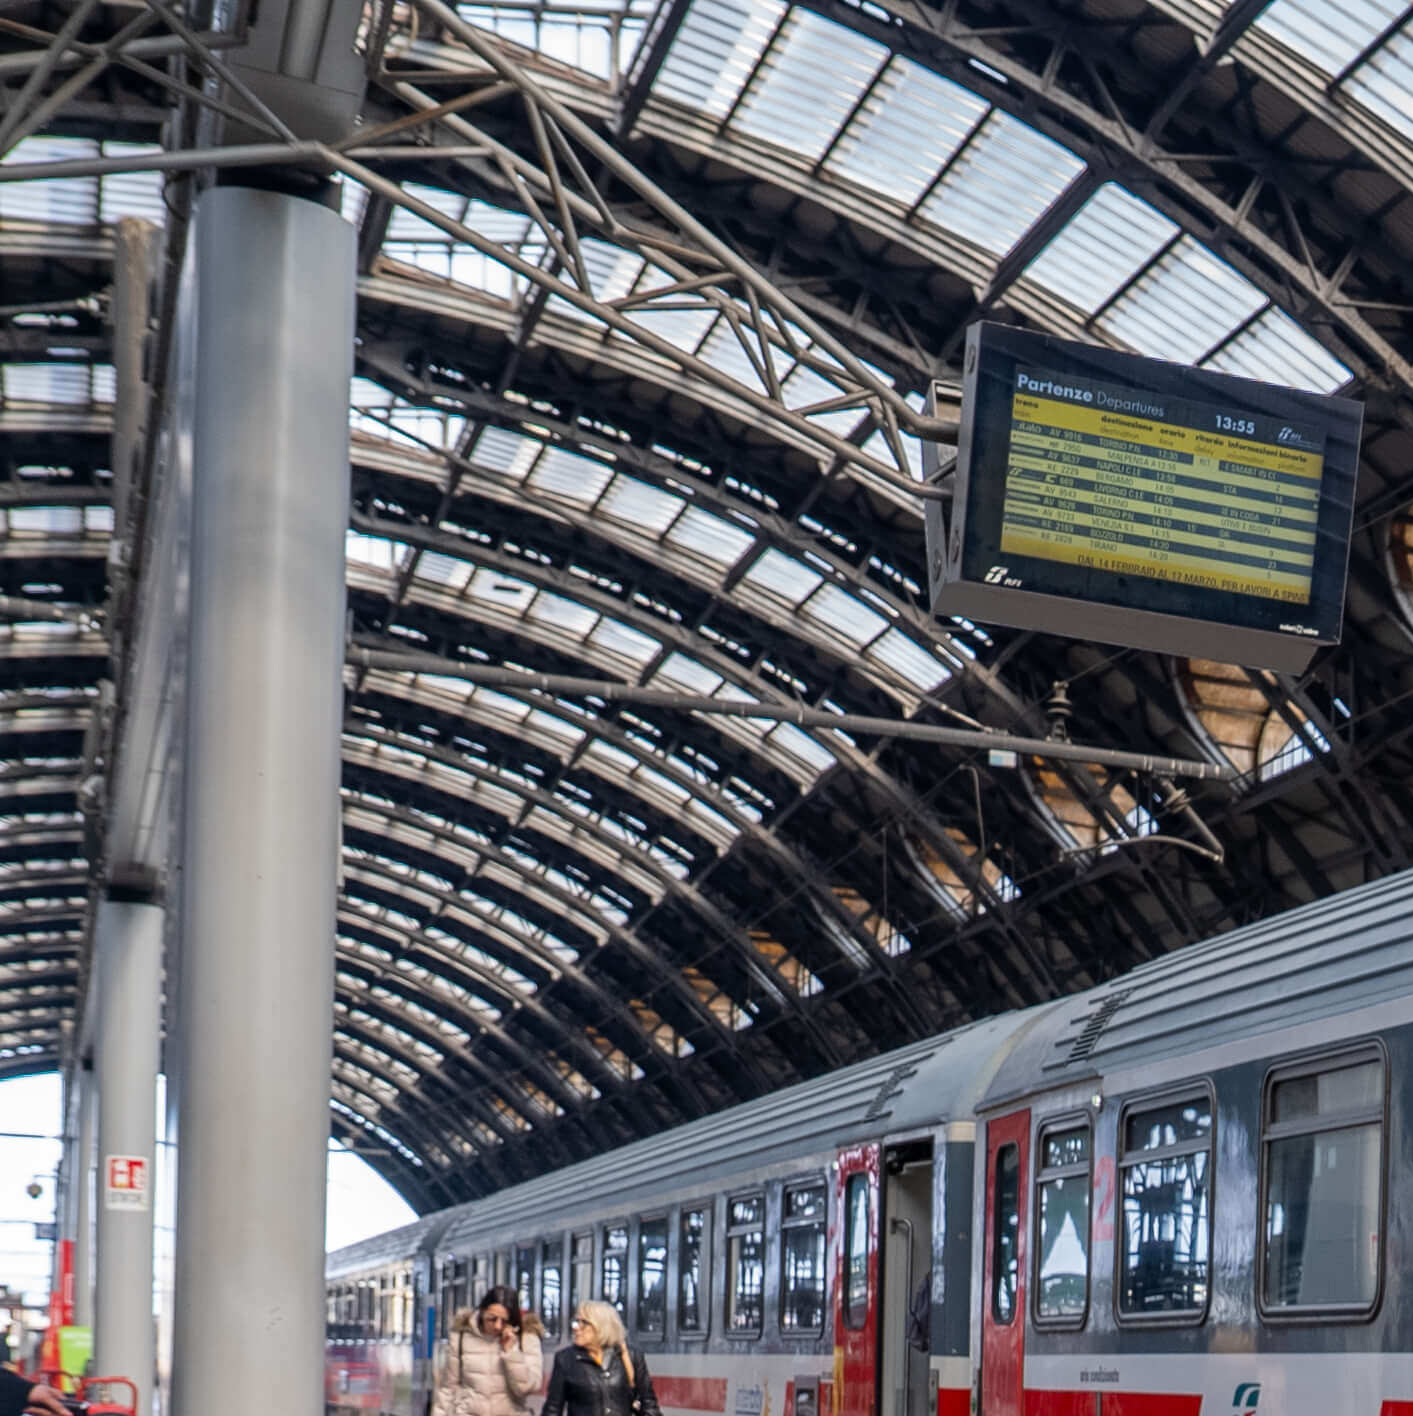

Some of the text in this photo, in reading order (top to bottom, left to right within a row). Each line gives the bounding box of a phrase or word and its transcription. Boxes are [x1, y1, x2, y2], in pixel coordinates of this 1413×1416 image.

[1017, 373, 1164, 420] Partenze Departures
[1214, 414, 1255, 435] 13:55
